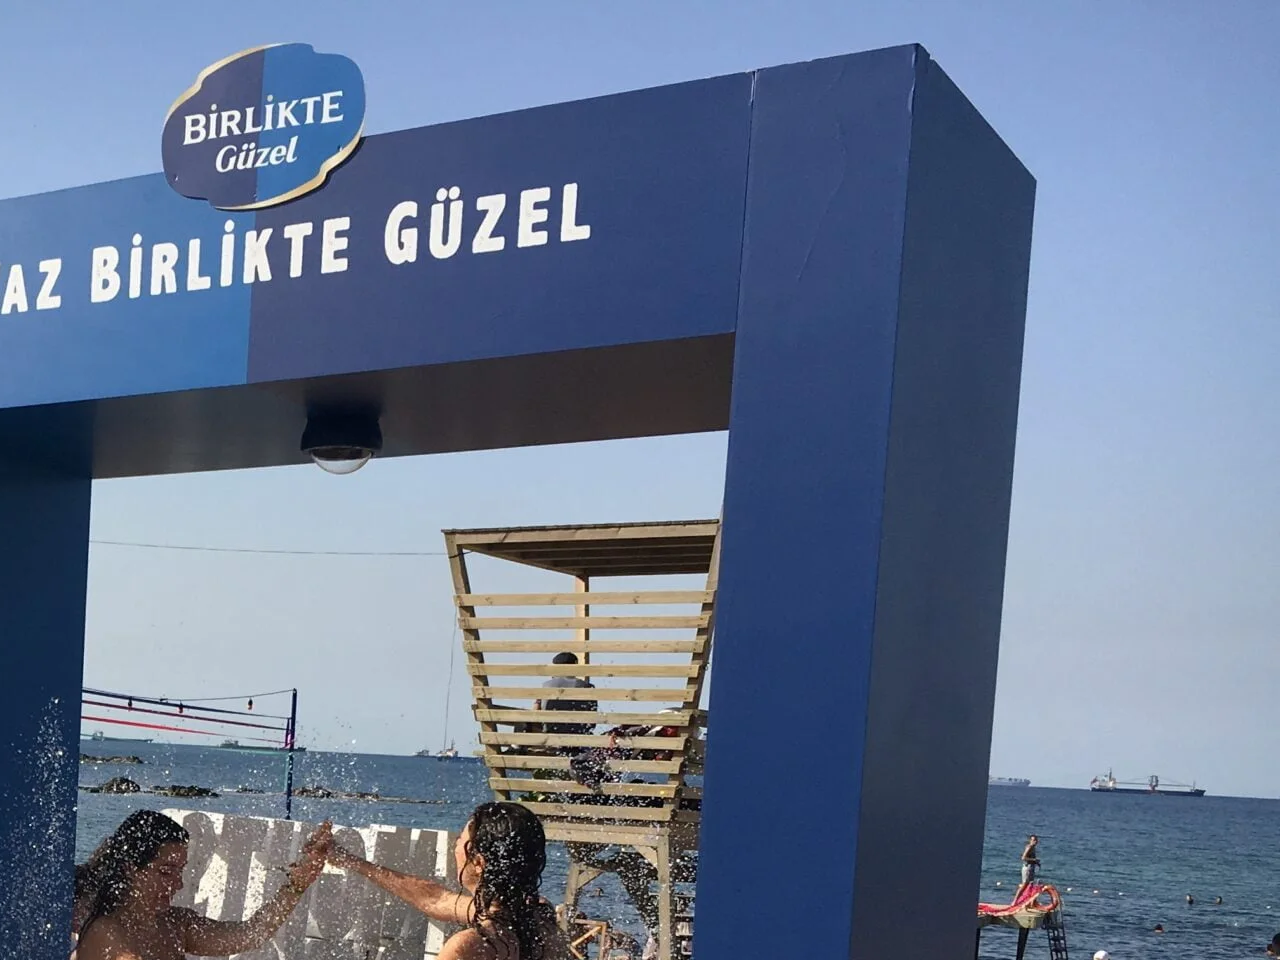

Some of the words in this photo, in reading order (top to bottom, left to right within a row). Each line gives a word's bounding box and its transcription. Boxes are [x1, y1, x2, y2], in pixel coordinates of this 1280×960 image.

[183, 90, 345, 146] BİRLİKTE
[215, 135, 298, 173] Güzel
[90, 216, 351, 303] BİRLİKTE
[384, 182, 592, 265] GÜZEL
